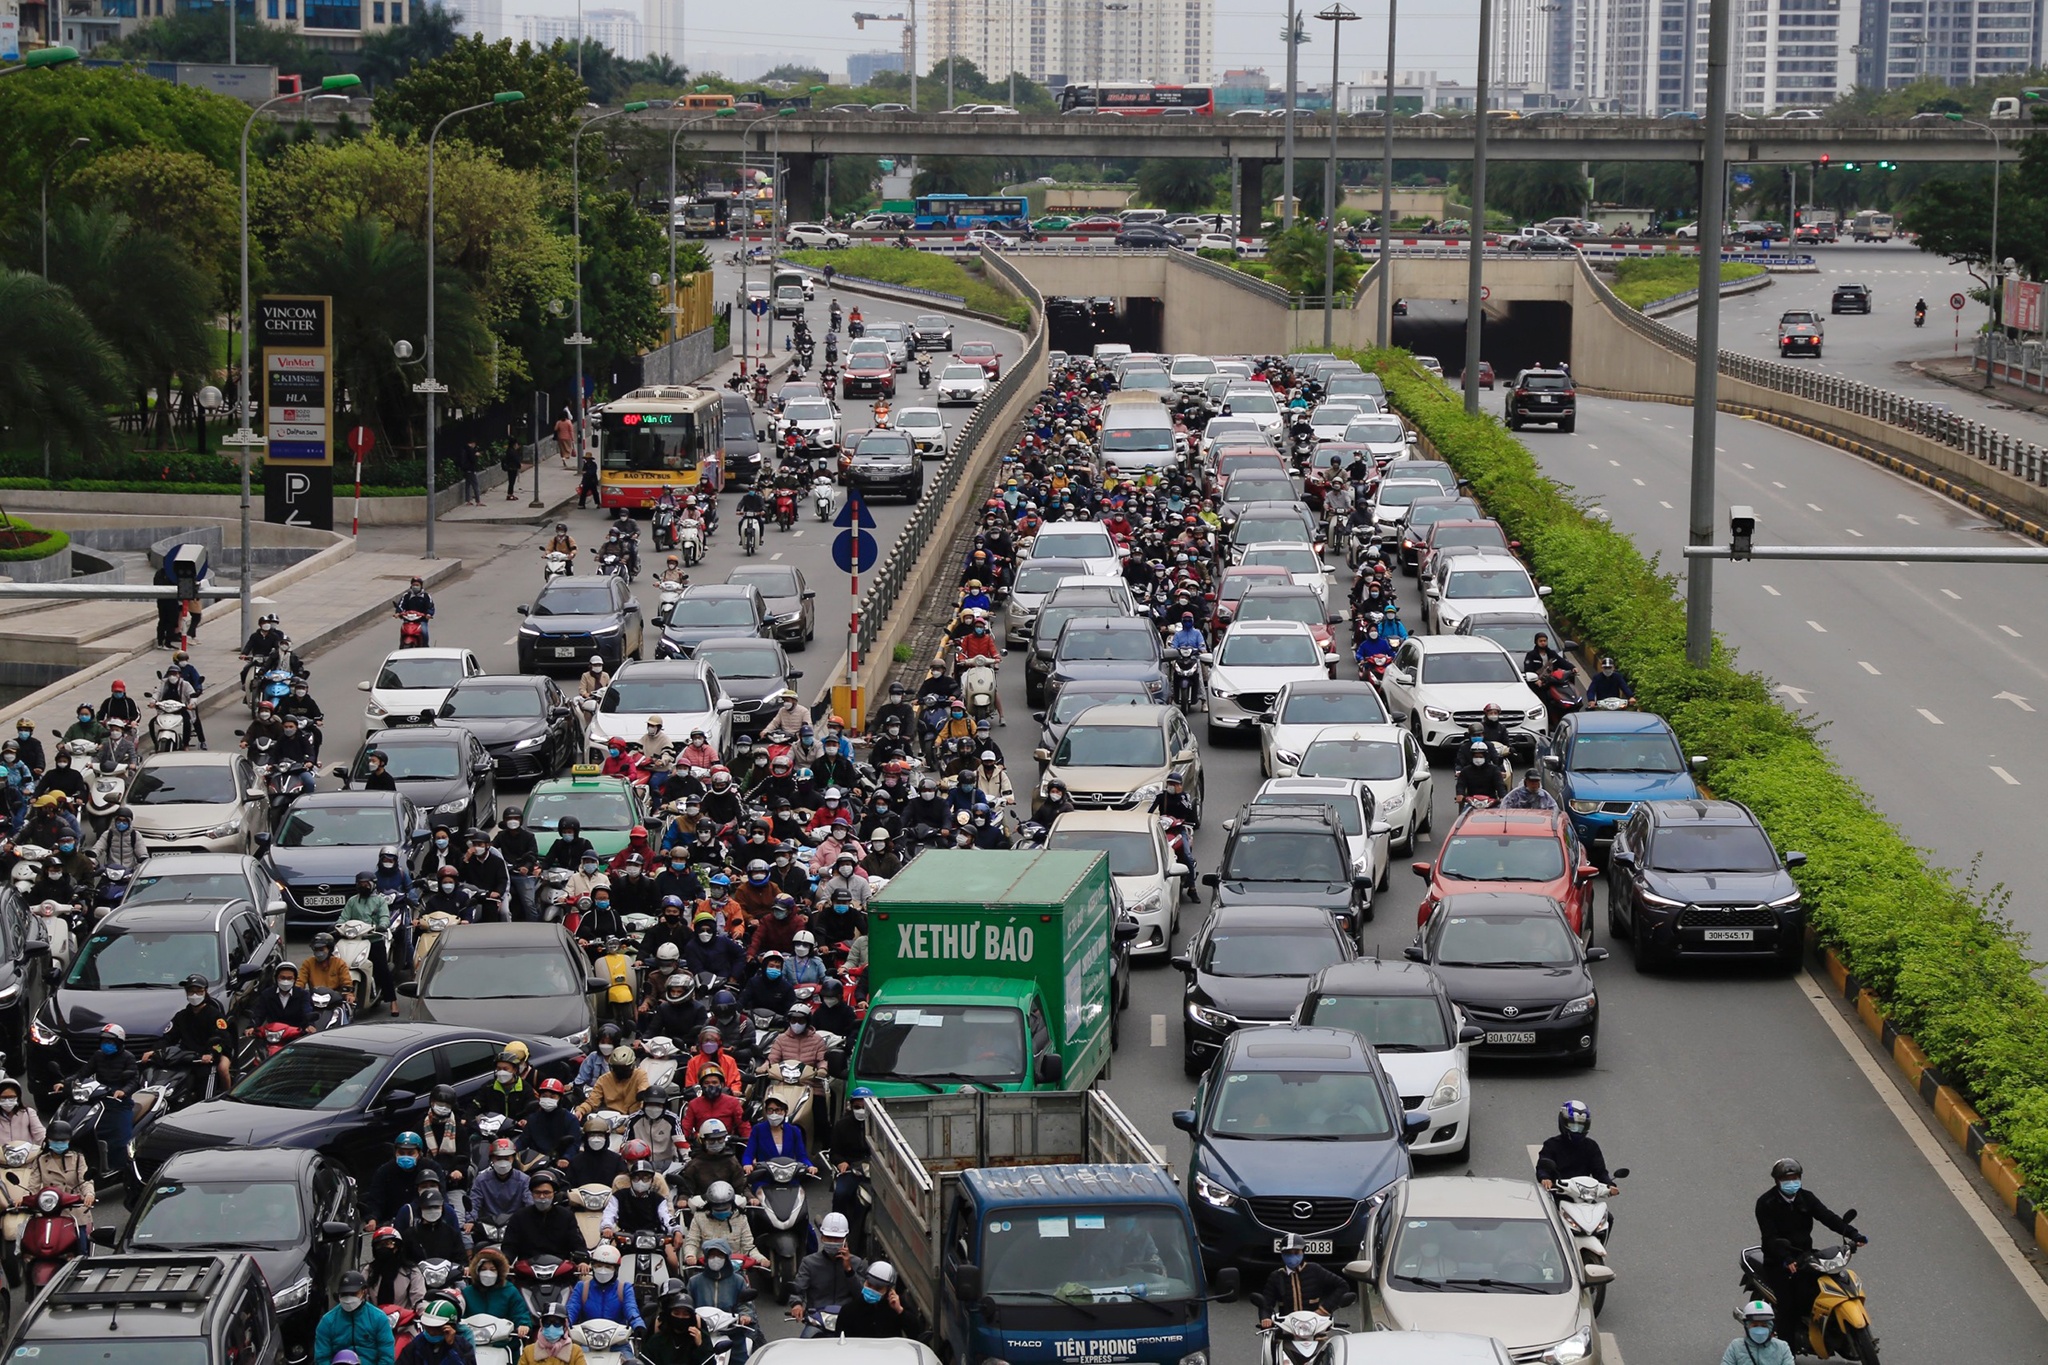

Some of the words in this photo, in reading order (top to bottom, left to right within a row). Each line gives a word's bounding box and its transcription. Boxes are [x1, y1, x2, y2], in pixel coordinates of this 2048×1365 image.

[263, 307, 317, 319] VINCOM
[264, 319, 315, 331] CENTER
[277, 357, 315, 368] VinMart
[286, 394, 307, 402] HLA
[286, 473, 310, 503] P
[985, 917, 1034, 962] BÁO
[1708, 931, 1750, 940] 30H-545.17
[1487, 1032, 1535, 1043] 30A-074.55
[1007, 1340, 1043, 1348] THACO
[1089, 1339, 1137, 1356] PHONG
[1136, 1335, 1183, 1345] FRONTIER
[1080, 1355, 1113, 1364] EXPRESS
